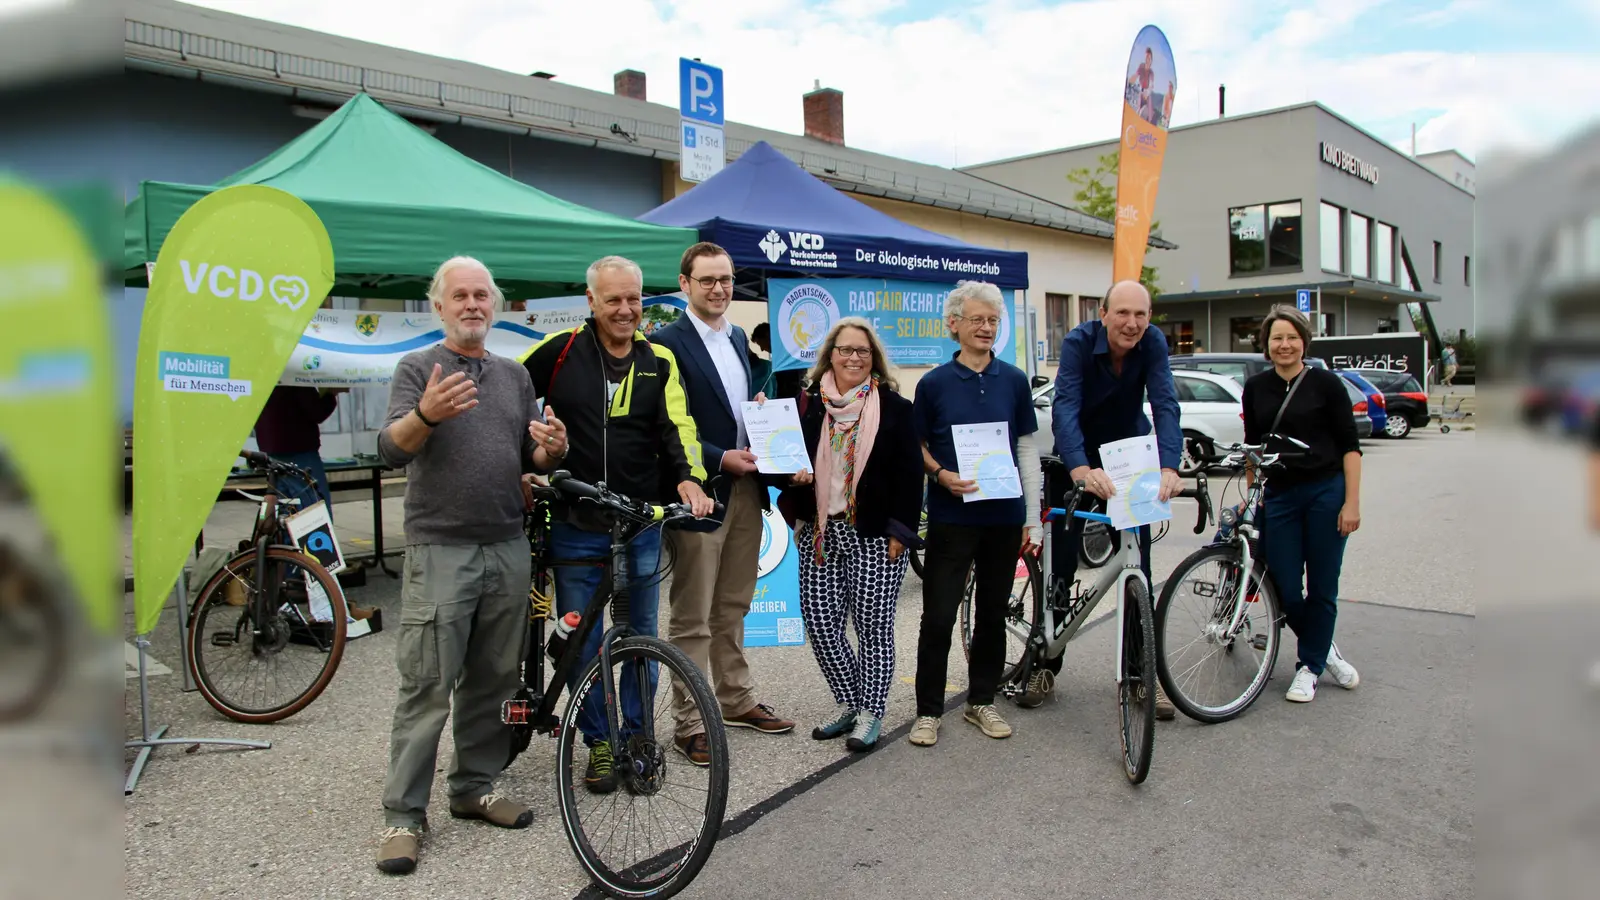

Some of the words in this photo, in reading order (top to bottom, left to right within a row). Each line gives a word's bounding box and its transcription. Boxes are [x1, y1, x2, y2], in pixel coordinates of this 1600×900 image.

[691, 68, 714, 112] P
[705, 136, 721, 149] Std.
[1138, 132, 1158, 148] adfc
[1322, 141, 1342, 168] KINO
[1341, 151, 1380, 184] BREITWAND
[1117, 204, 1139, 221] adfc
[789, 231, 824, 250] VCD
[790, 250, 837, 260] Verkehrsclub
[790, 258, 838, 268] Deutschland
[855, 248, 875, 262] Der
[878, 250, 940, 270] ökologische
[941, 257, 1000, 275] Verkehrsclub
[179, 260, 264, 302] VCD
[786, 287, 832, 308] RADENTSCHEID
[848, 290, 933, 313] RADFAIRKEHR
[1300, 292, 1307, 310] P
[542, 314, 586, 325] PLANEGG
[897, 317, 916, 338] SEI
[800, 350, 816, 359] BAYE
[164, 357, 225, 375] Mobilität
[170, 378, 189, 389] für
[190, 379, 246, 393] Menschen
